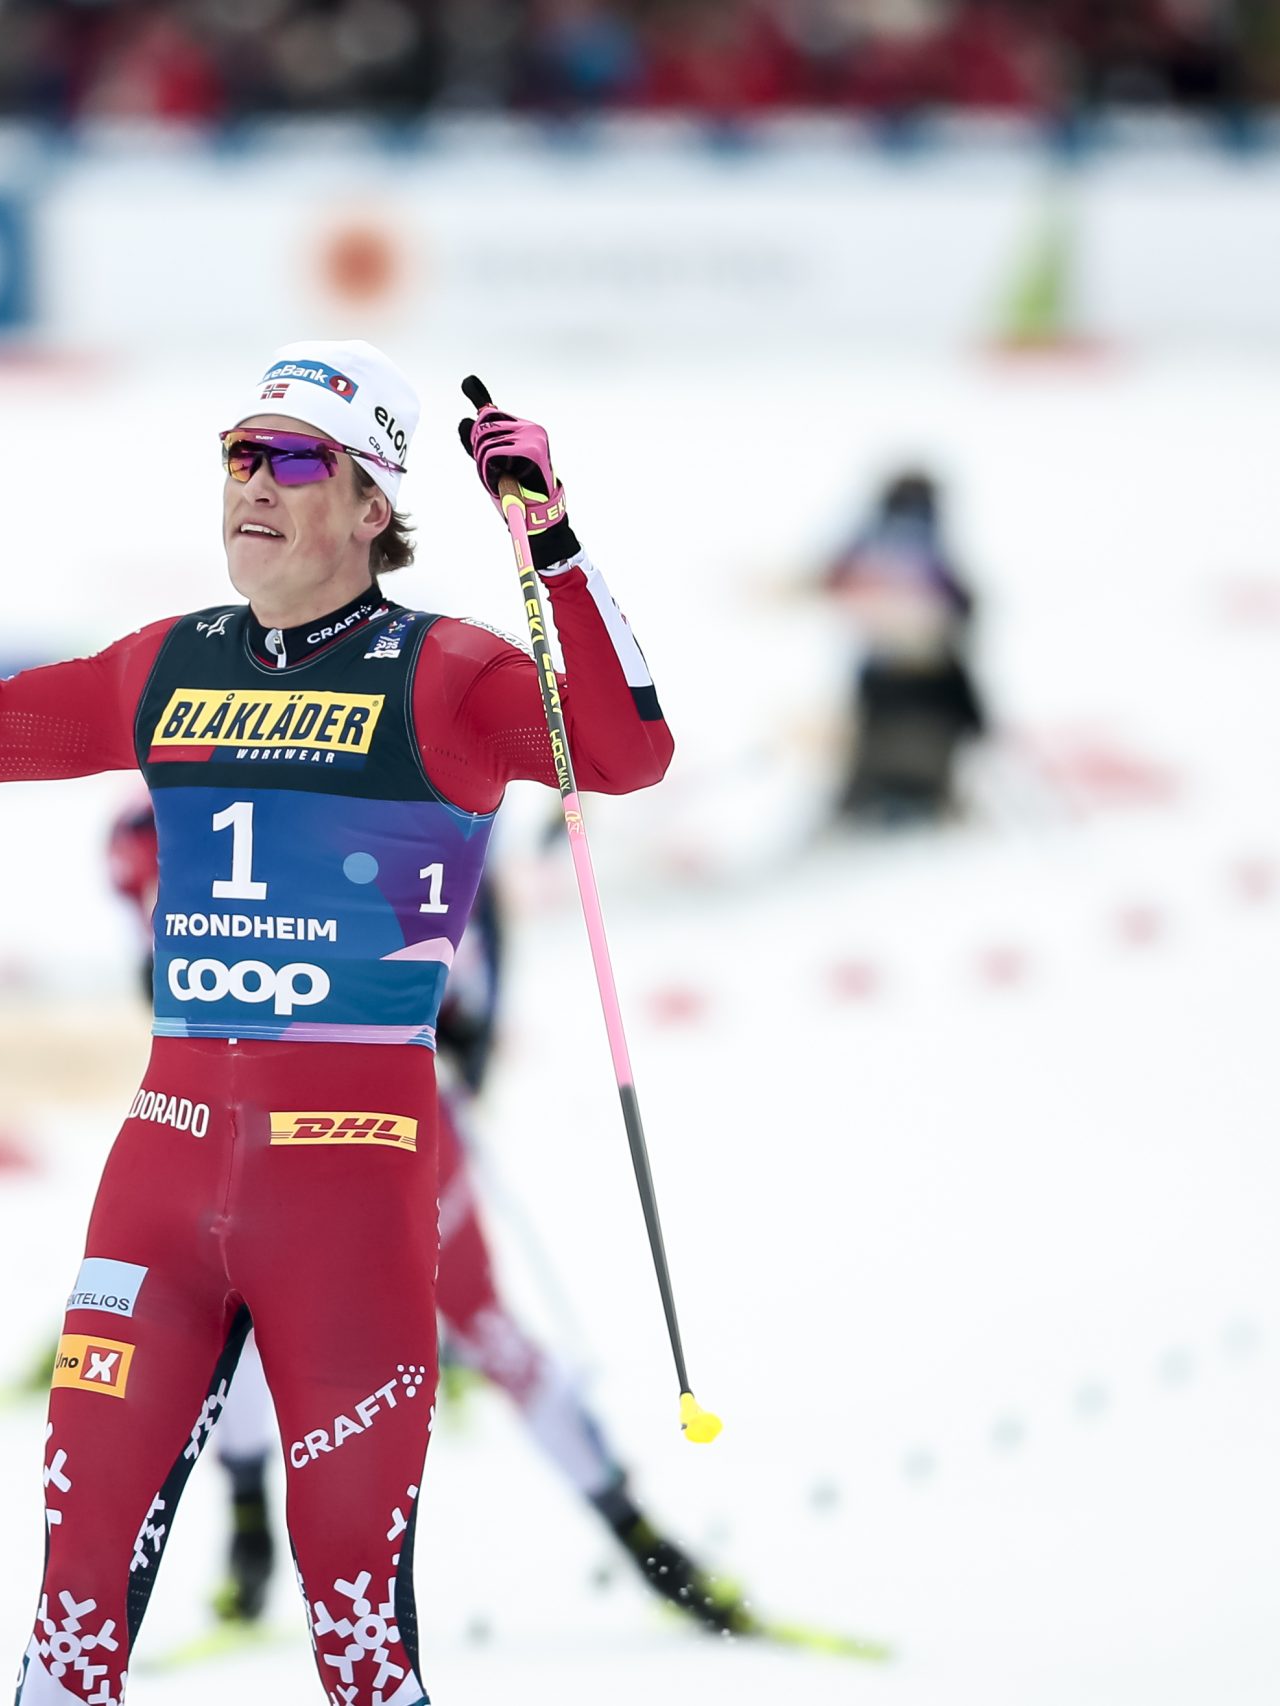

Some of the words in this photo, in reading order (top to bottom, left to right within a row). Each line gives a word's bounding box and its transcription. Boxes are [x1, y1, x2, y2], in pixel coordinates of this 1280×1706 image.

[307, 611, 361, 644] CRAFT
[162, 693, 372, 747] BLÅKLÄDER
[236, 747, 335, 764] WORKWEAR
[212, 802, 267, 900] 1
[419, 863, 449, 913] 1
[166, 913, 337, 942] TRONDHEIM
[168, 958, 331, 1015] coop
[292, 1118, 402, 1142] DHL
[84, 1352, 119, 1382] X
[291, 1379, 398, 1469] CRAFT
